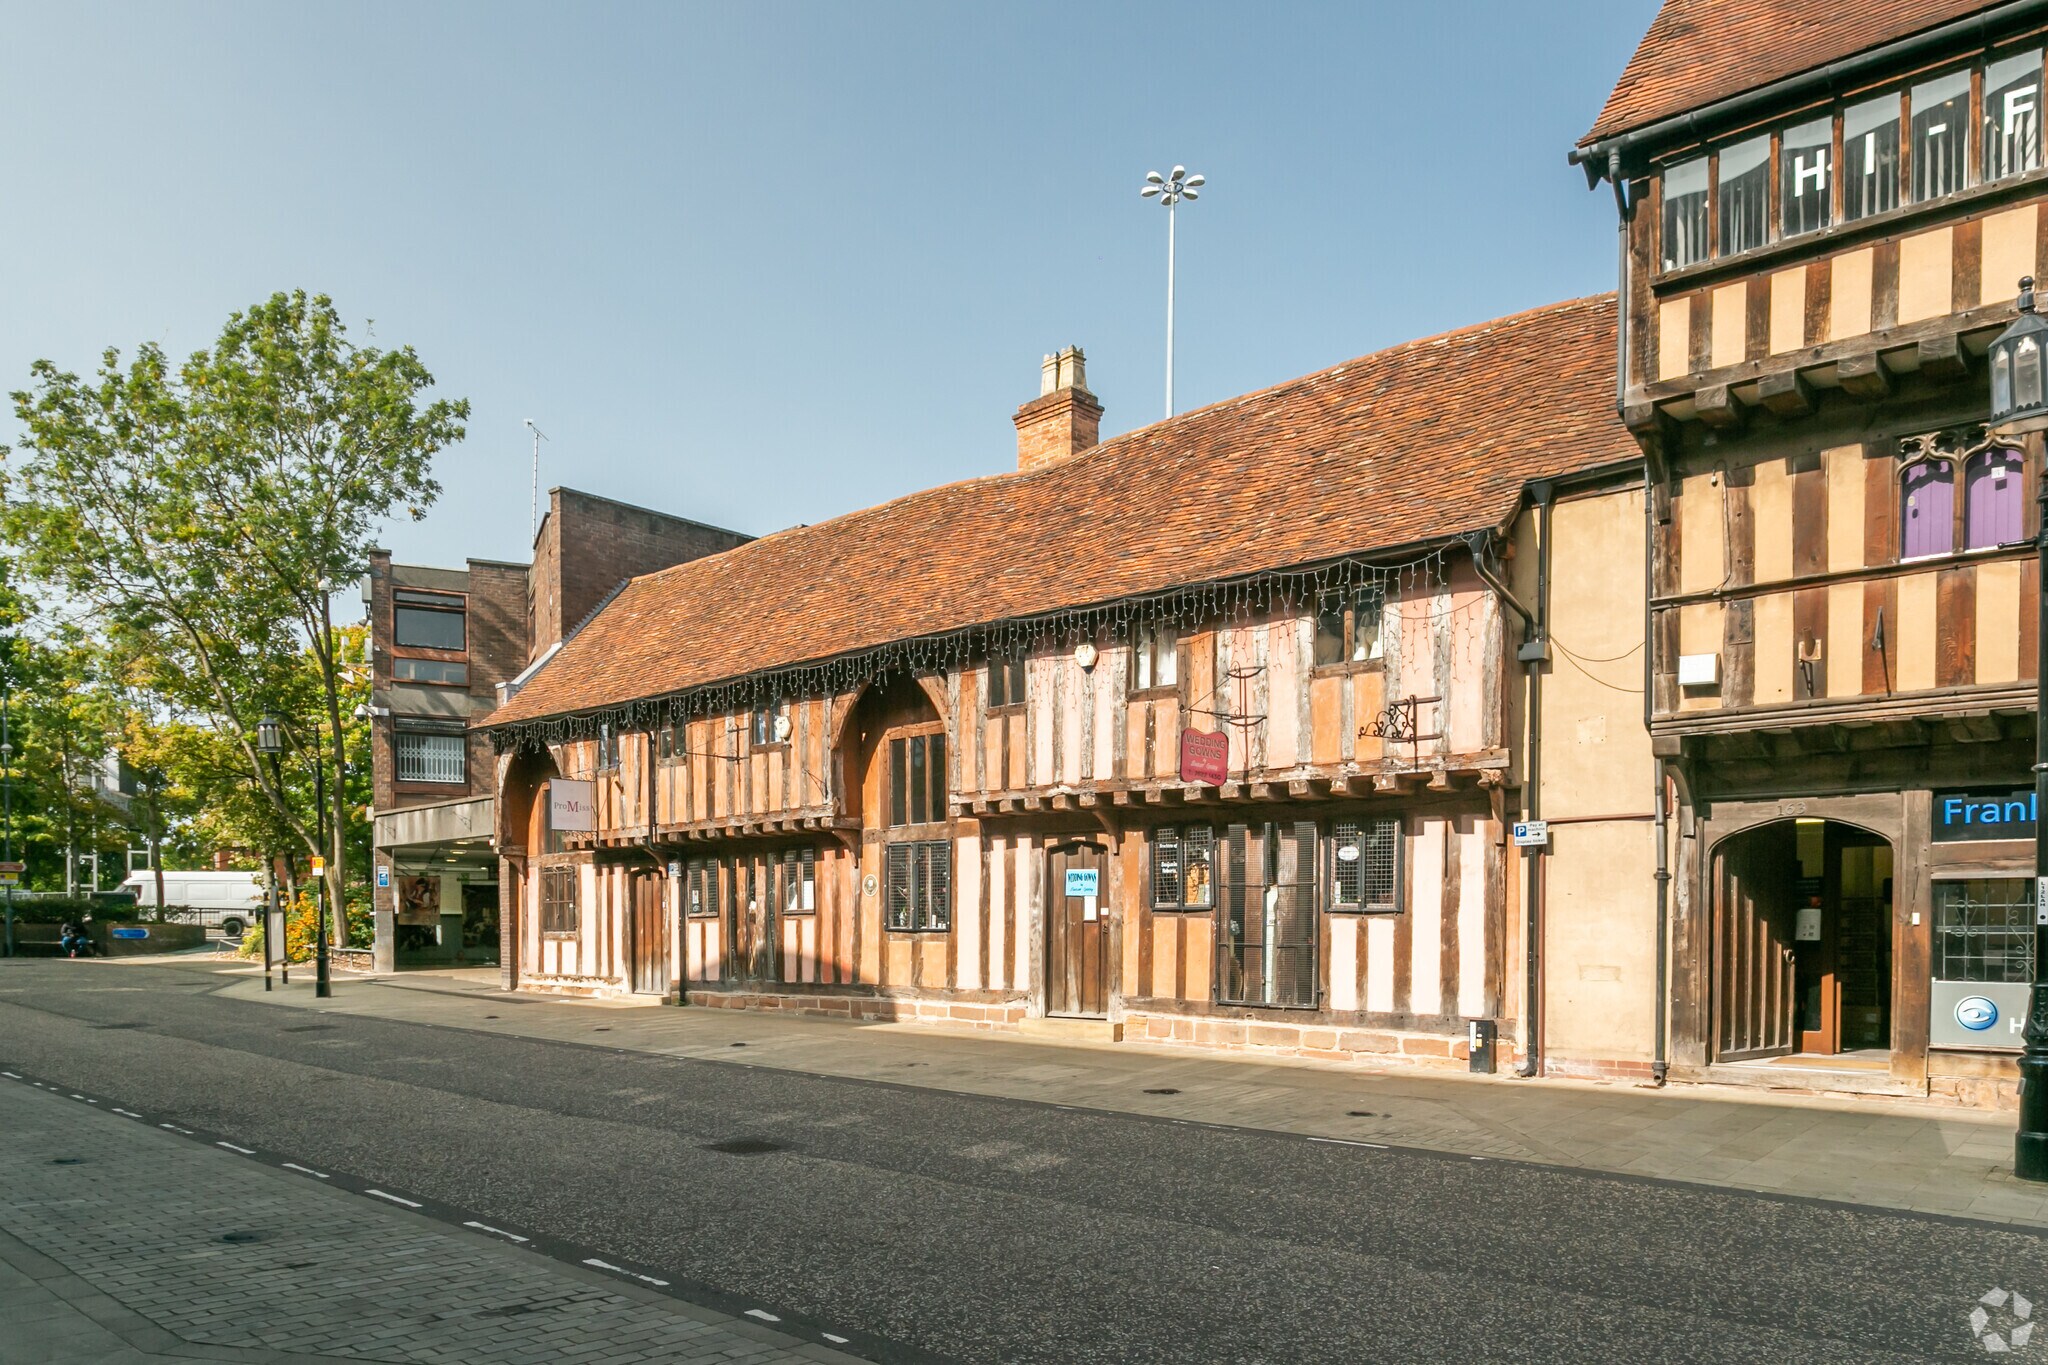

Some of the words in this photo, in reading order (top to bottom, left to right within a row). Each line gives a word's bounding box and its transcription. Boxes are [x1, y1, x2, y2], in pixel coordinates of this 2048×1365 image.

[1186, 734, 1225, 750] WEDDING
[1189, 746, 1222, 759] GOWNS
[1777, 801, 1806, 816] 163
